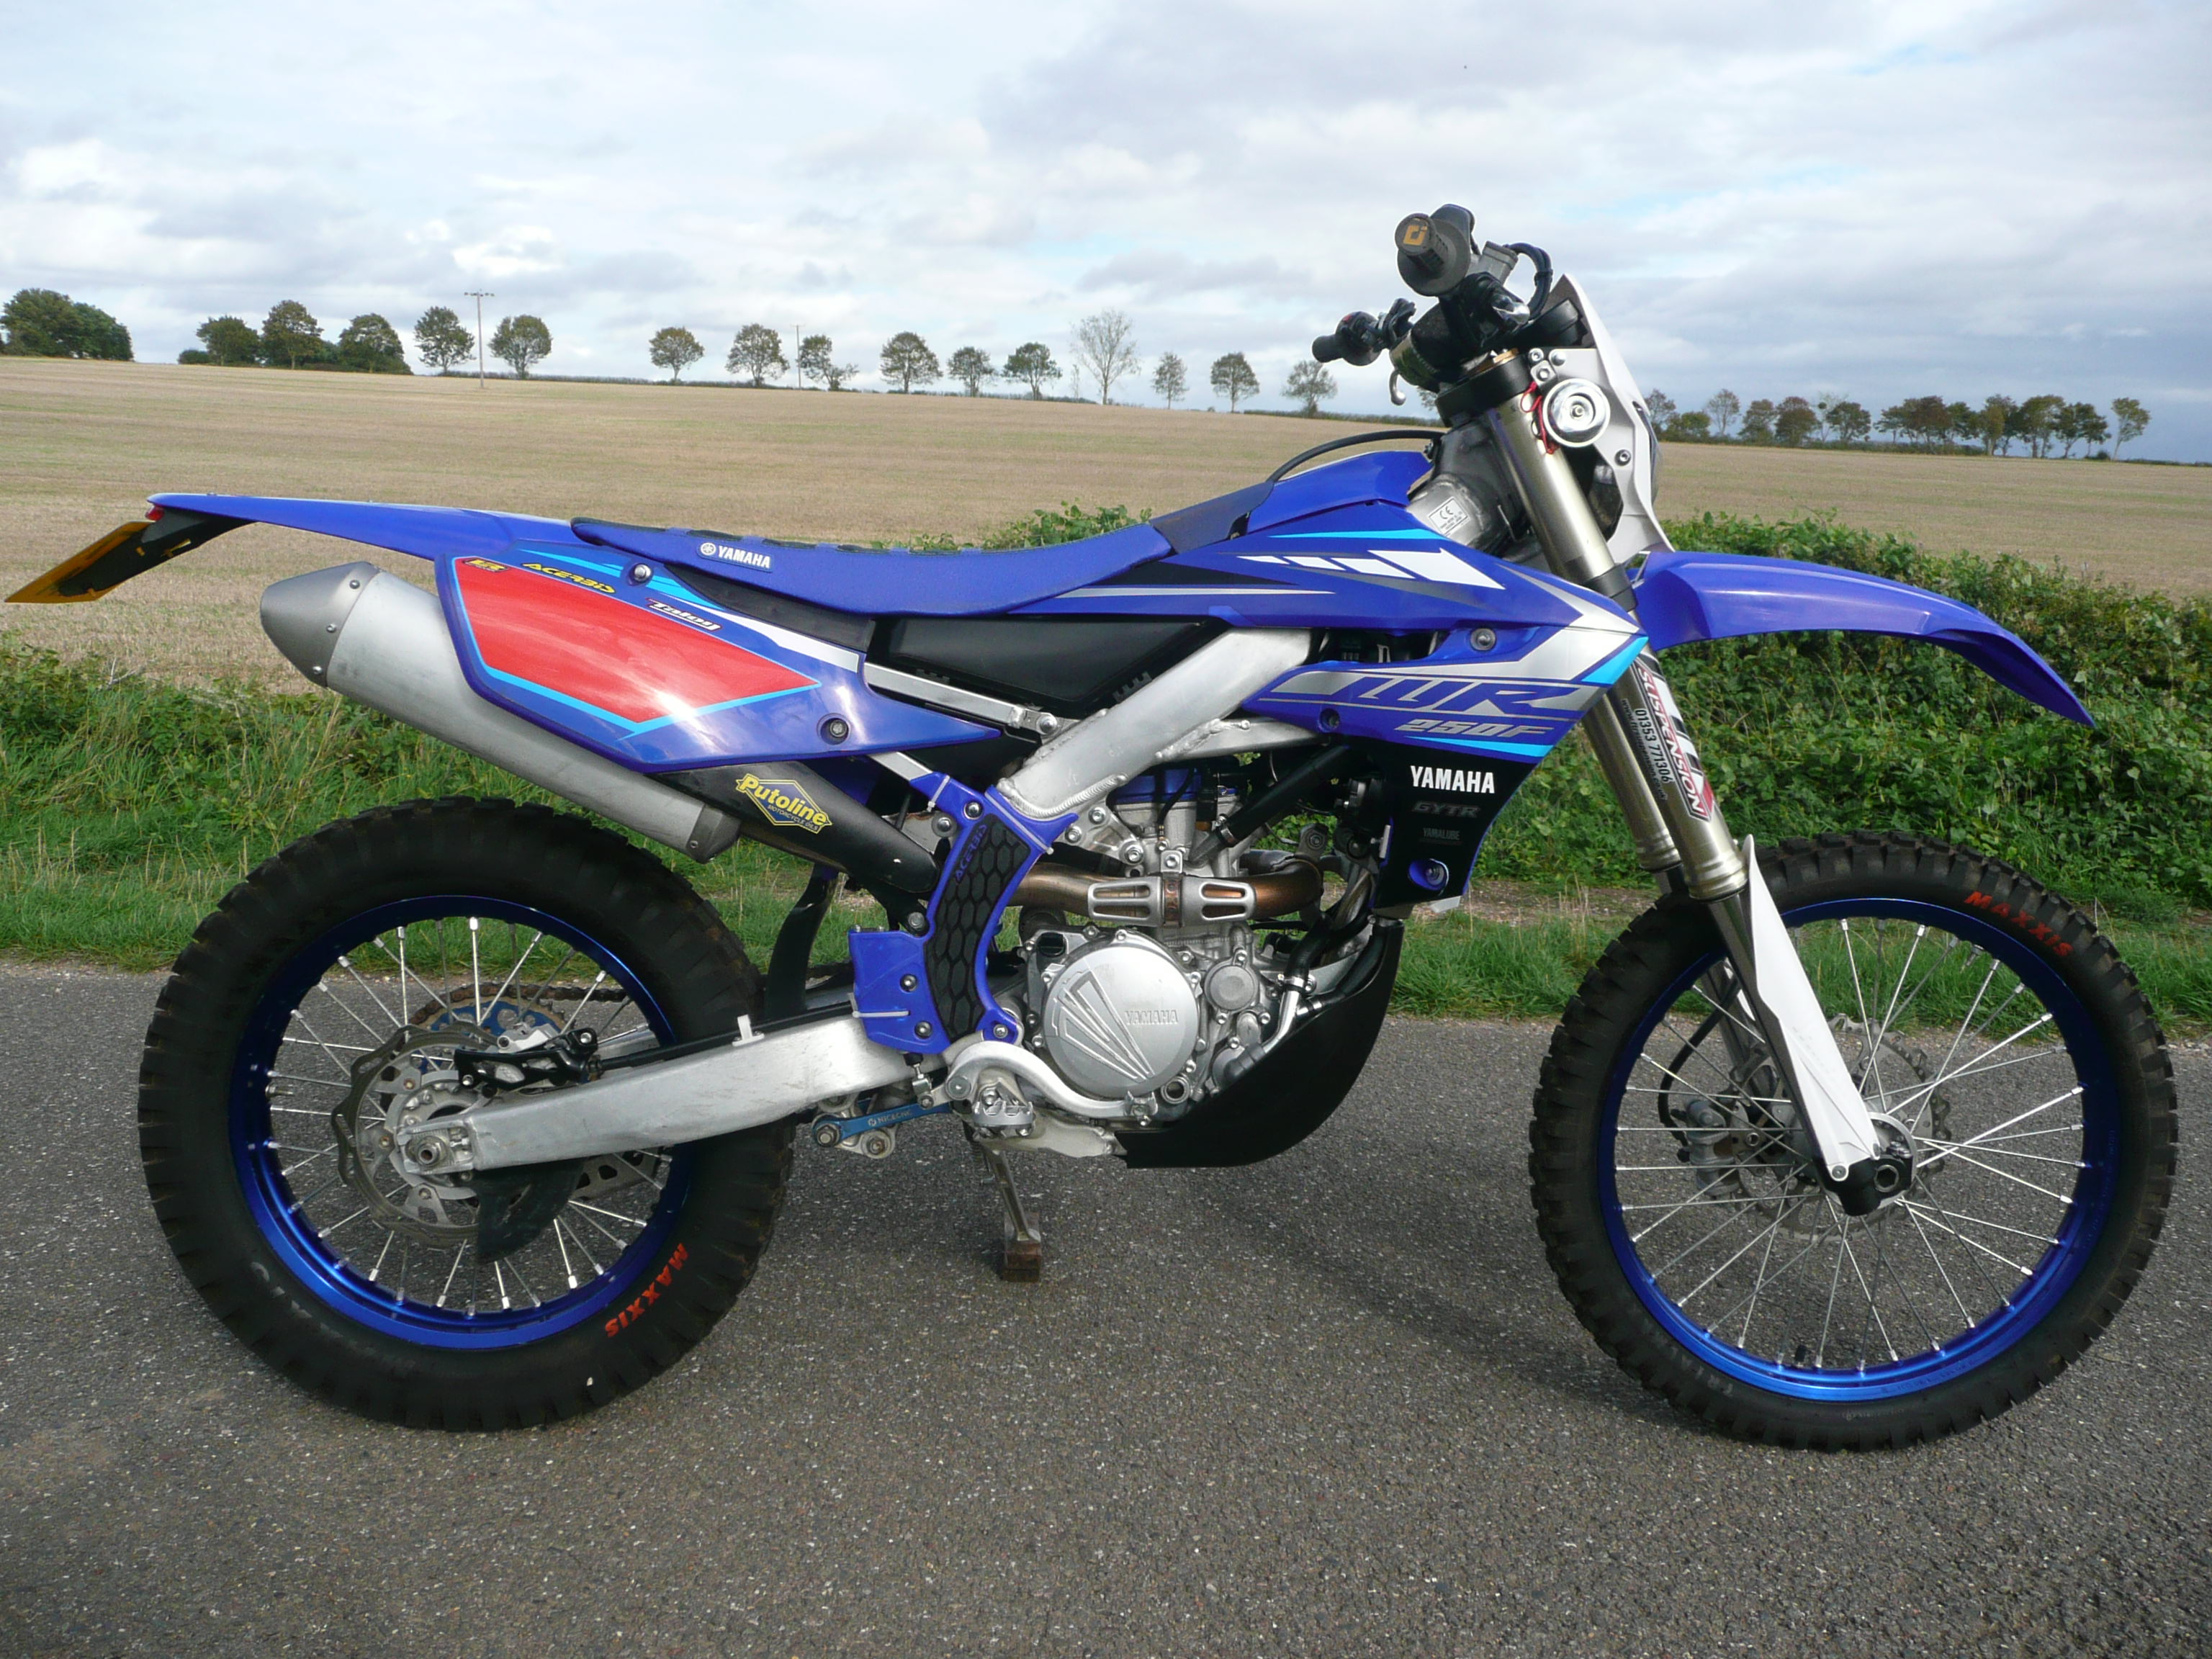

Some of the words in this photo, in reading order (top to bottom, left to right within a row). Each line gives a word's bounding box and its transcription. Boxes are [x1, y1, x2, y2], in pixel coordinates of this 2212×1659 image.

[718, 545, 770, 569] YAMAHA
[1394, 719, 1554, 738] 250F
[1635, 708, 1657, 742] 01353
[1649, 744, 1674, 783] 771306
[1638, 667, 1705, 814] SUSPENSION
[1410, 765, 1495, 793] YAMAHA
[738, 775, 827, 826] Putoline
[1412, 800, 1480, 818] GYTR
[1964, 891, 2074, 957] MAXXIS
[1125, 1010, 1178, 1025] YAMAHA
[605, 1242, 689, 1337] MAXXIS
